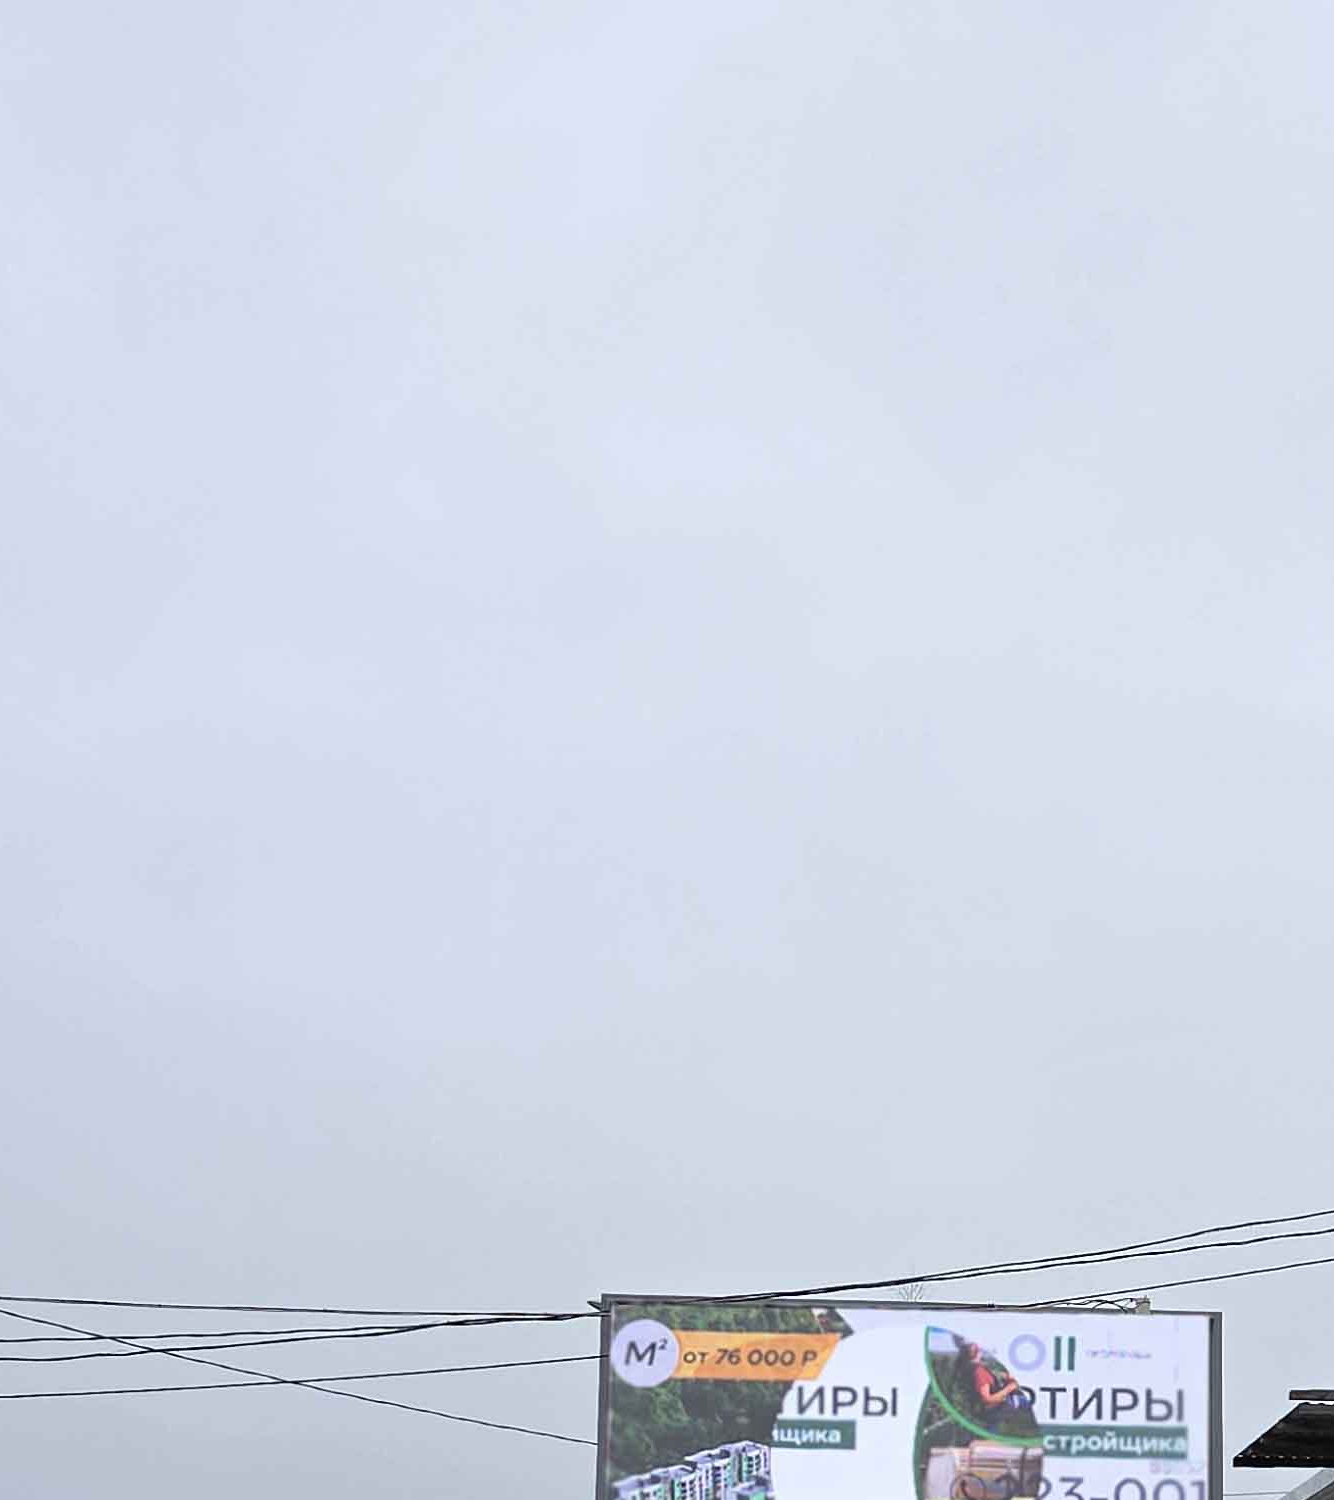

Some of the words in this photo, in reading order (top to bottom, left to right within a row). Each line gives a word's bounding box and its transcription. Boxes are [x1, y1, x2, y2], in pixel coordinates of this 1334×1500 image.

[683, 1350, 707, 1365] от
[714, 1348, 740, 1366] 76
[747, 1349, 796, 1367] 000
